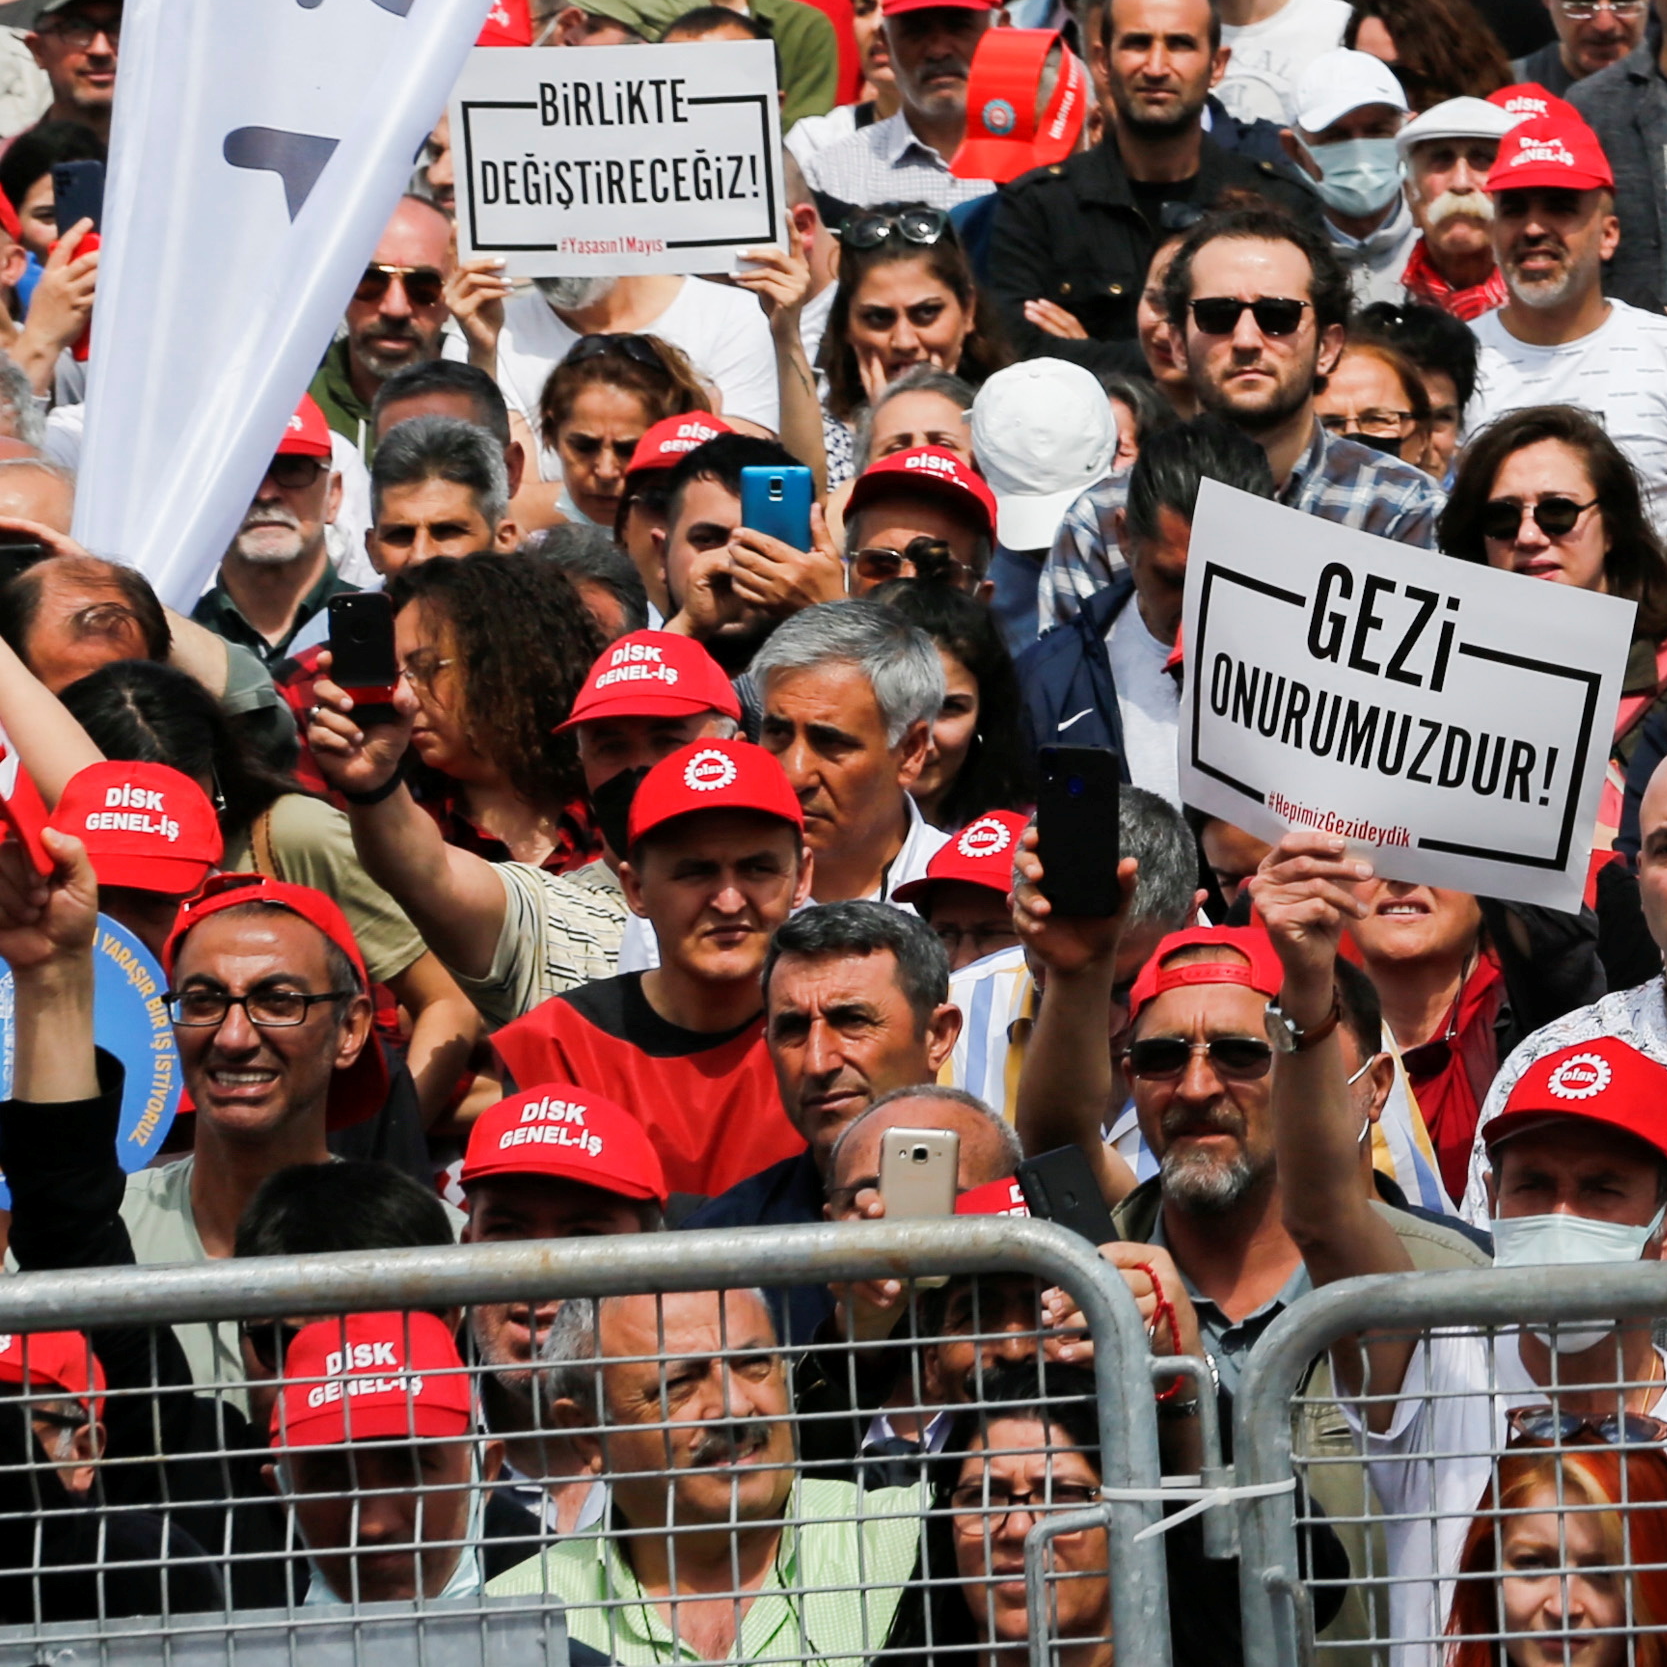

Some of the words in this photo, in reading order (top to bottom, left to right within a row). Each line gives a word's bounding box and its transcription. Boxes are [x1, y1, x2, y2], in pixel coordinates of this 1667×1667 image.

[539, 77, 690, 128] BİRLİKTE
[480, 153, 760, 210] DEĞİŞTİRECEĞİZ!
[905, 452, 957, 475] DİSK
[1305, 561, 1461, 693] GEZİ
[610, 641, 663, 667] DİSK
[595, 661, 679, 689] GENEL-İŞ
[1209, 651, 1561, 807] ONURUMUZDUR!
[694, 764, 726, 779] DİSK
[104, 783, 166, 812] DİSK
[85, 812, 181, 843] GENEL-İŞ
[1267, 790, 1412, 850] #HepimizGezideydik
[966, 828, 1000, 846] DİSK
[101, 931, 157, 999] YARAŞIR
[1560, 1066, 1600, 1085] DİSK
[520, 1096, 587, 1126] DİSK
[498, 1121, 605, 1157] GENEL-İŞ
[324, 1340, 398, 1375] DİSK
